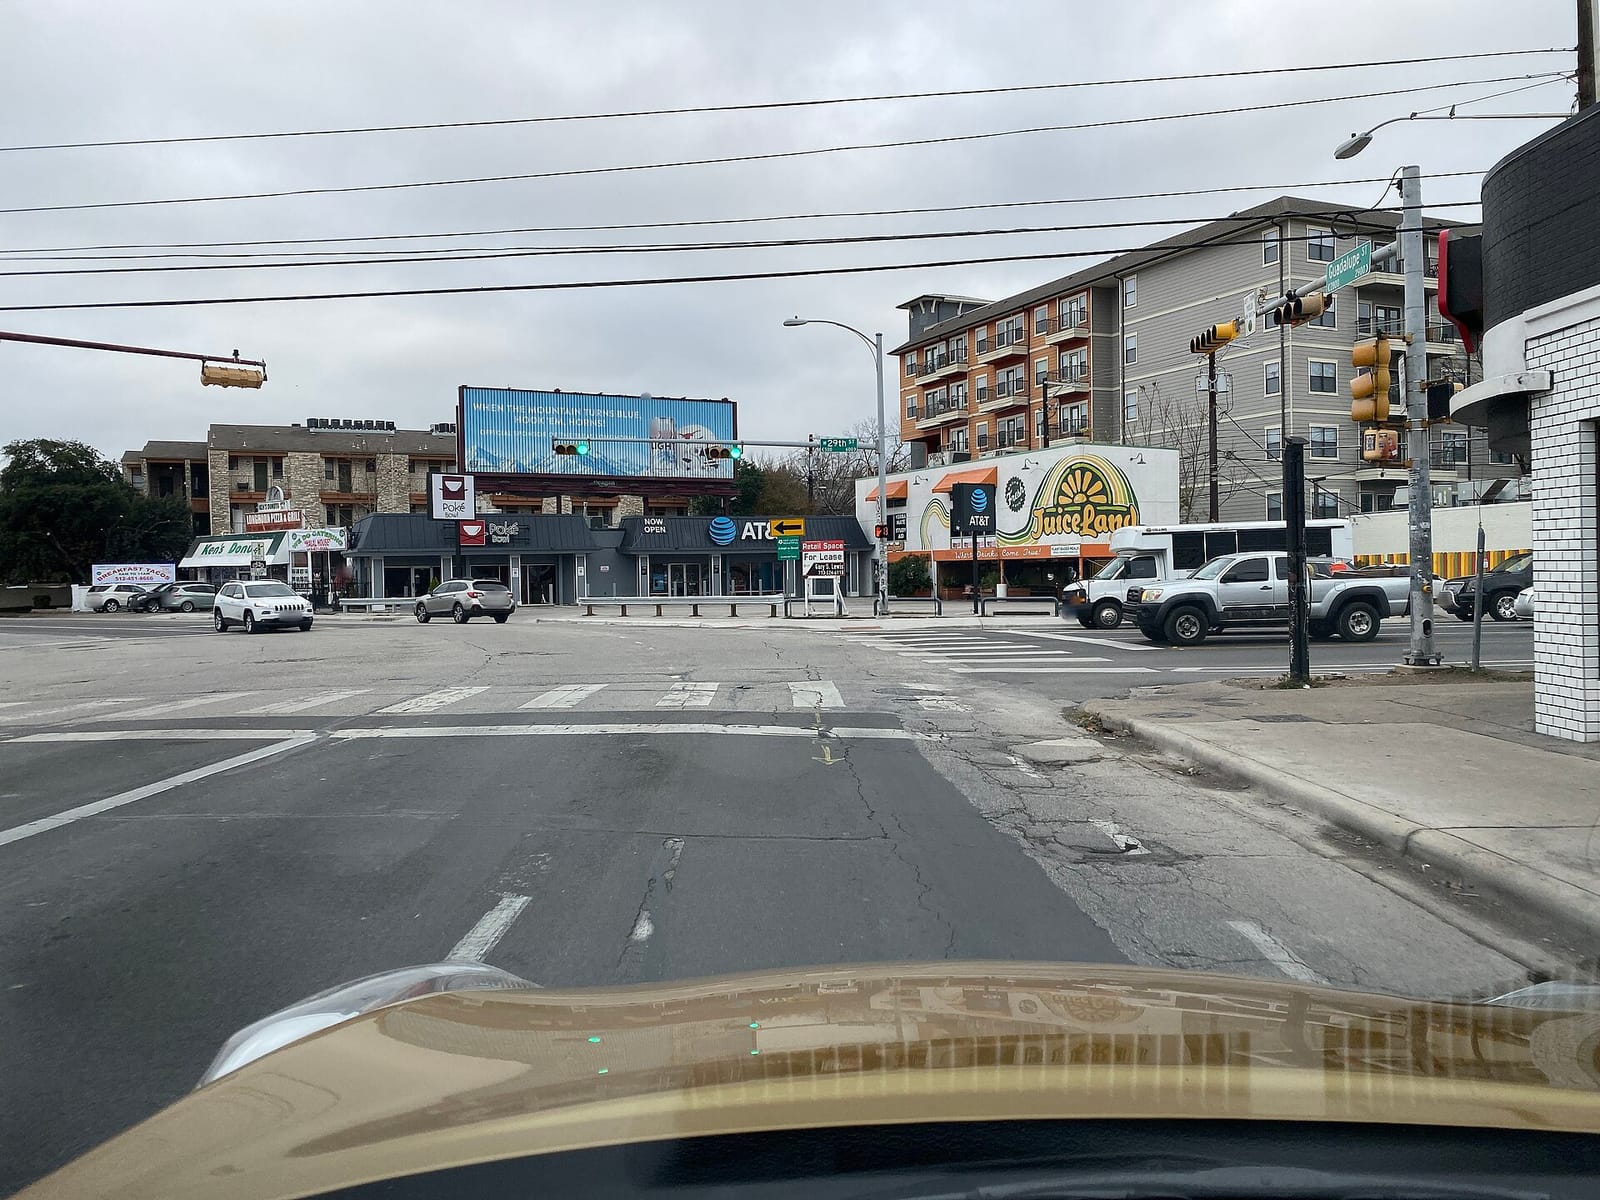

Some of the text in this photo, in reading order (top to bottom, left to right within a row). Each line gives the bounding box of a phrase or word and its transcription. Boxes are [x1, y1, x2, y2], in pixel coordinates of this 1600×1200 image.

[1328, 244, 1369, 279] Guadalupe ST
[473, 402, 504, 412] WHEN
[507, 404, 526, 413] THE
[528, 405, 582, 417] MOUNTAIN
[827, 439, 847, 448] 29th
[442, 501, 466, 513] Poké
[644, 518, 664, 526] NOW
[969, 515, 990, 527] AT&T
[1031, 503, 1138, 539] JuiceLand
[489, 521, 520, 536] Poké
[644, 526, 667, 534] OPEN
[741, 521, 777, 541] AT&
[201, 541, 252, 556] Ken's Donu
[802, 542, 822, 550] Retail
[823, 542, 844, 551] Space
[1001, 548, 1020, 557] Come
[804, 552, 843, 561] For Lease
[97, 567, 170, 582] BREAKFAST TACOS
